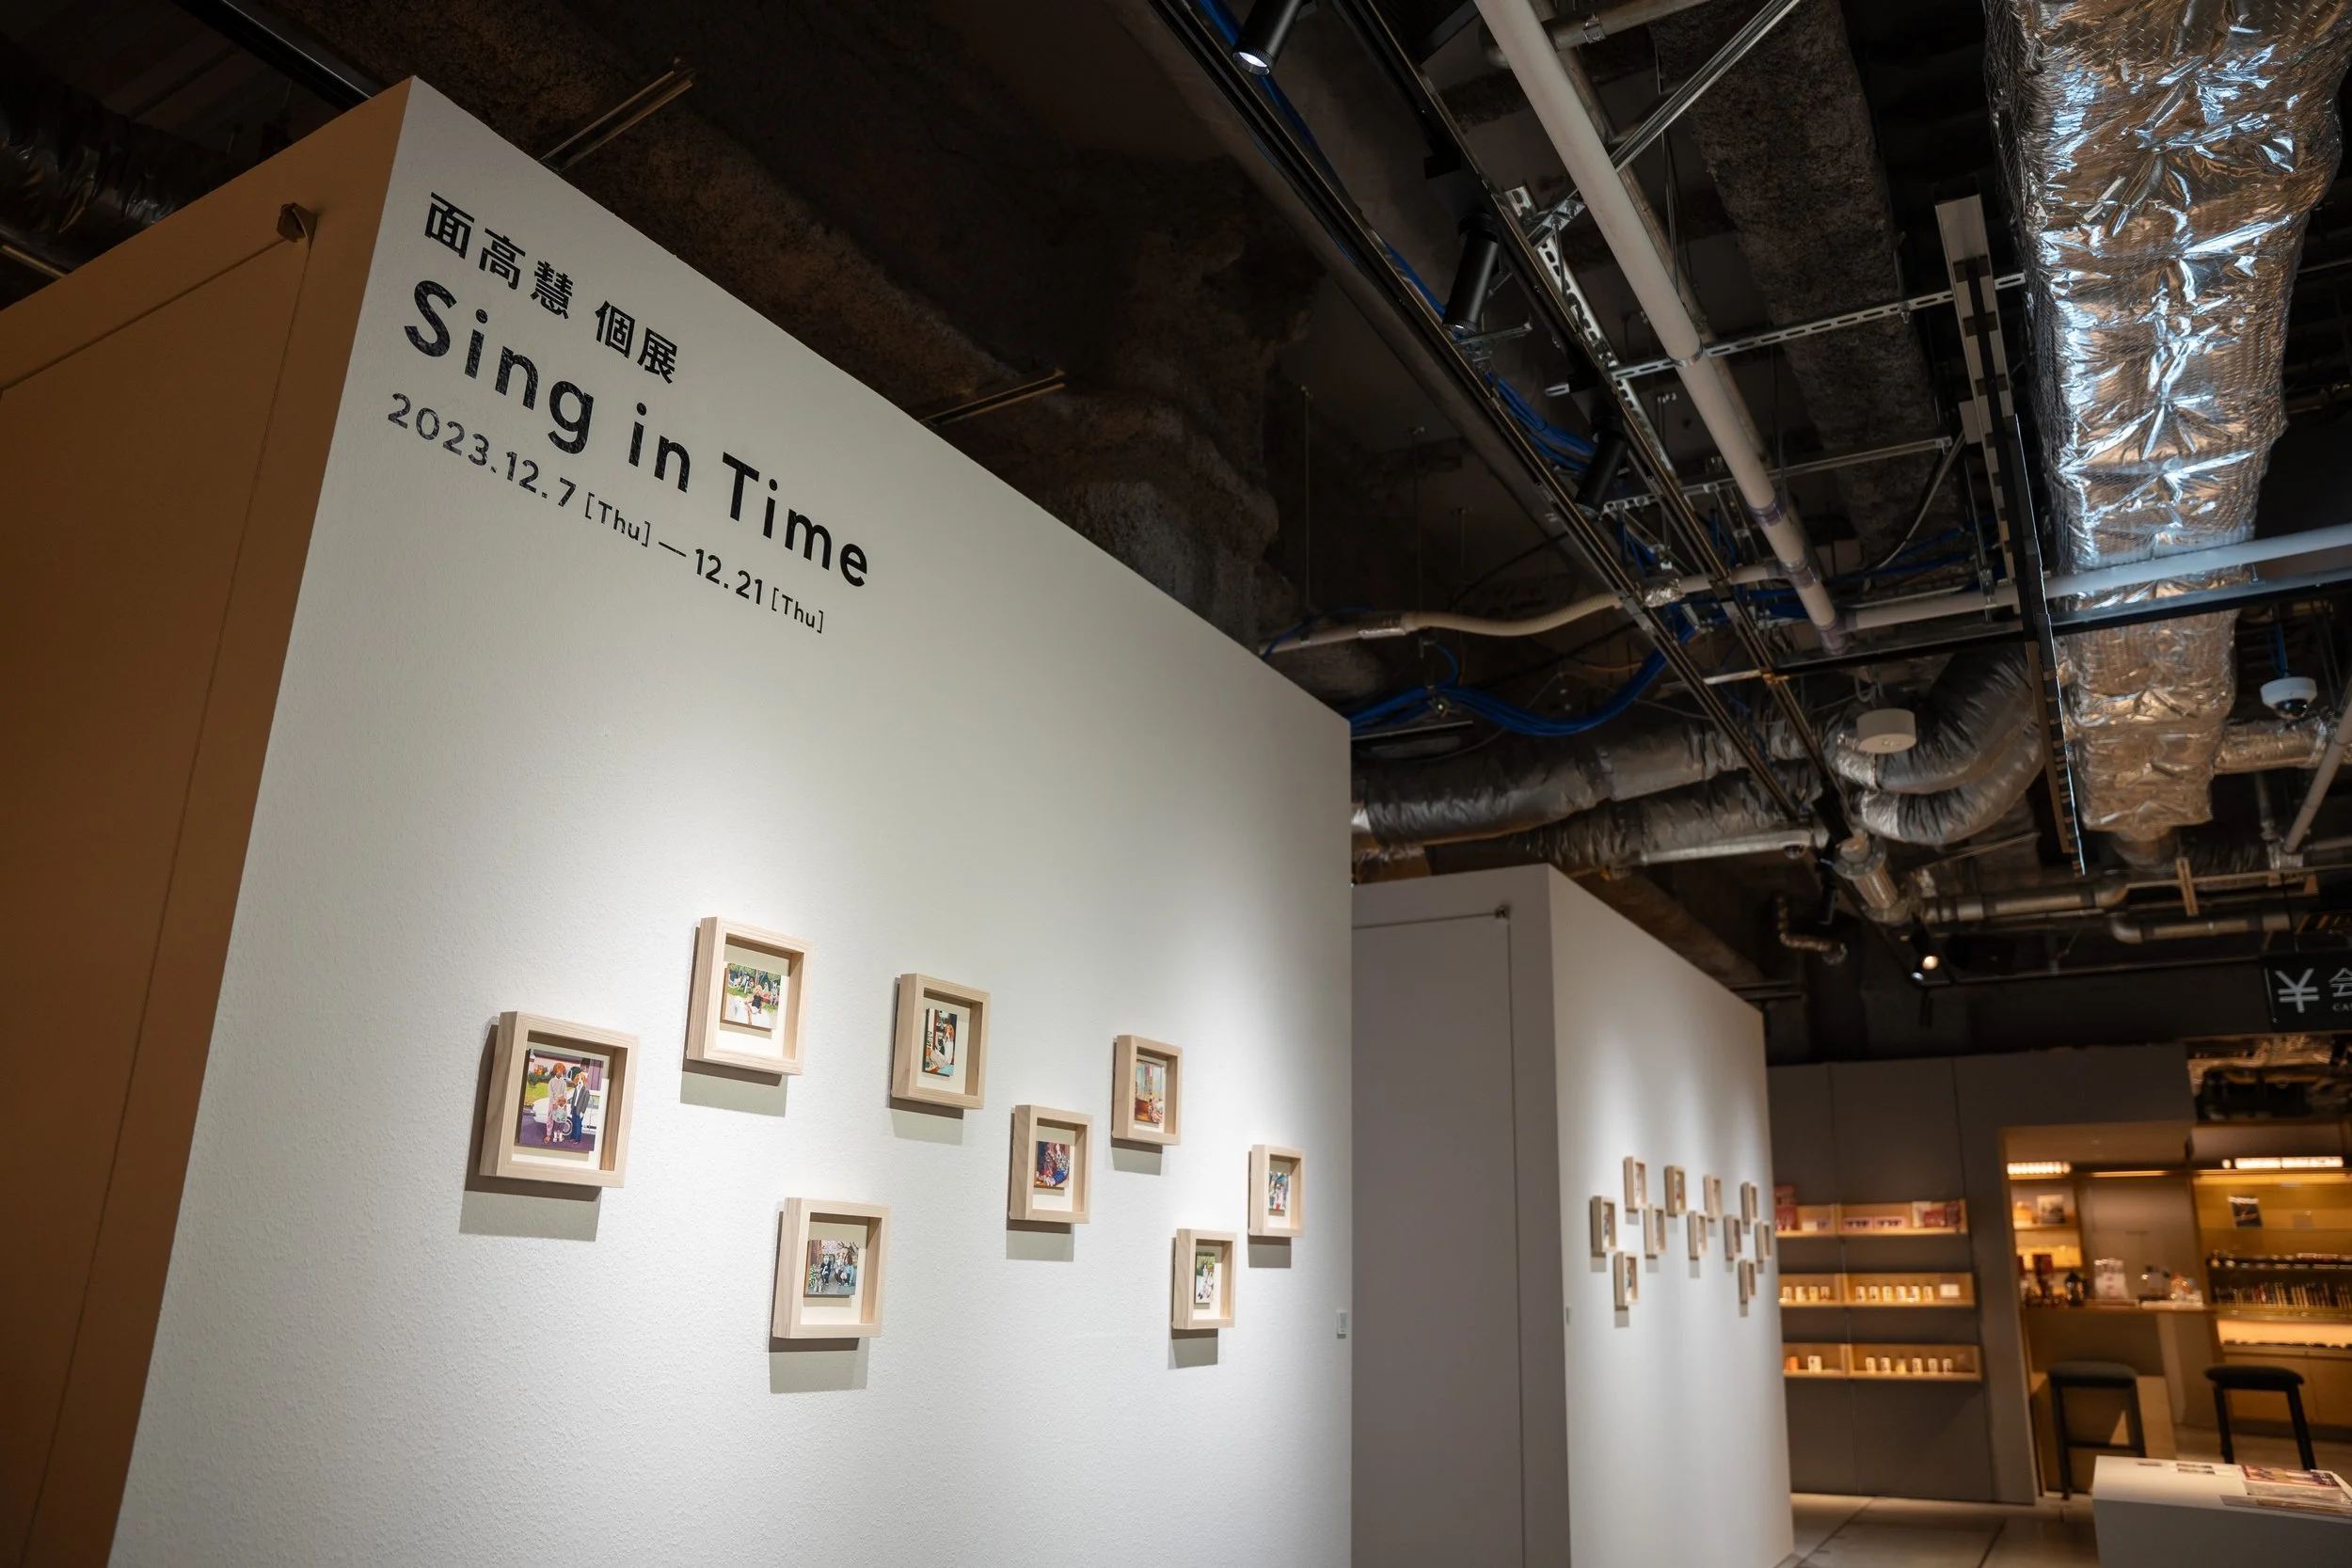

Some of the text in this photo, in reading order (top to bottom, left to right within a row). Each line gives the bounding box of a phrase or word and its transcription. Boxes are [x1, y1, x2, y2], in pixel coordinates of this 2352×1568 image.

[423, 191, 678, 385] 面高慧 個展
[404, 279, 867, 588] Sing in Time
